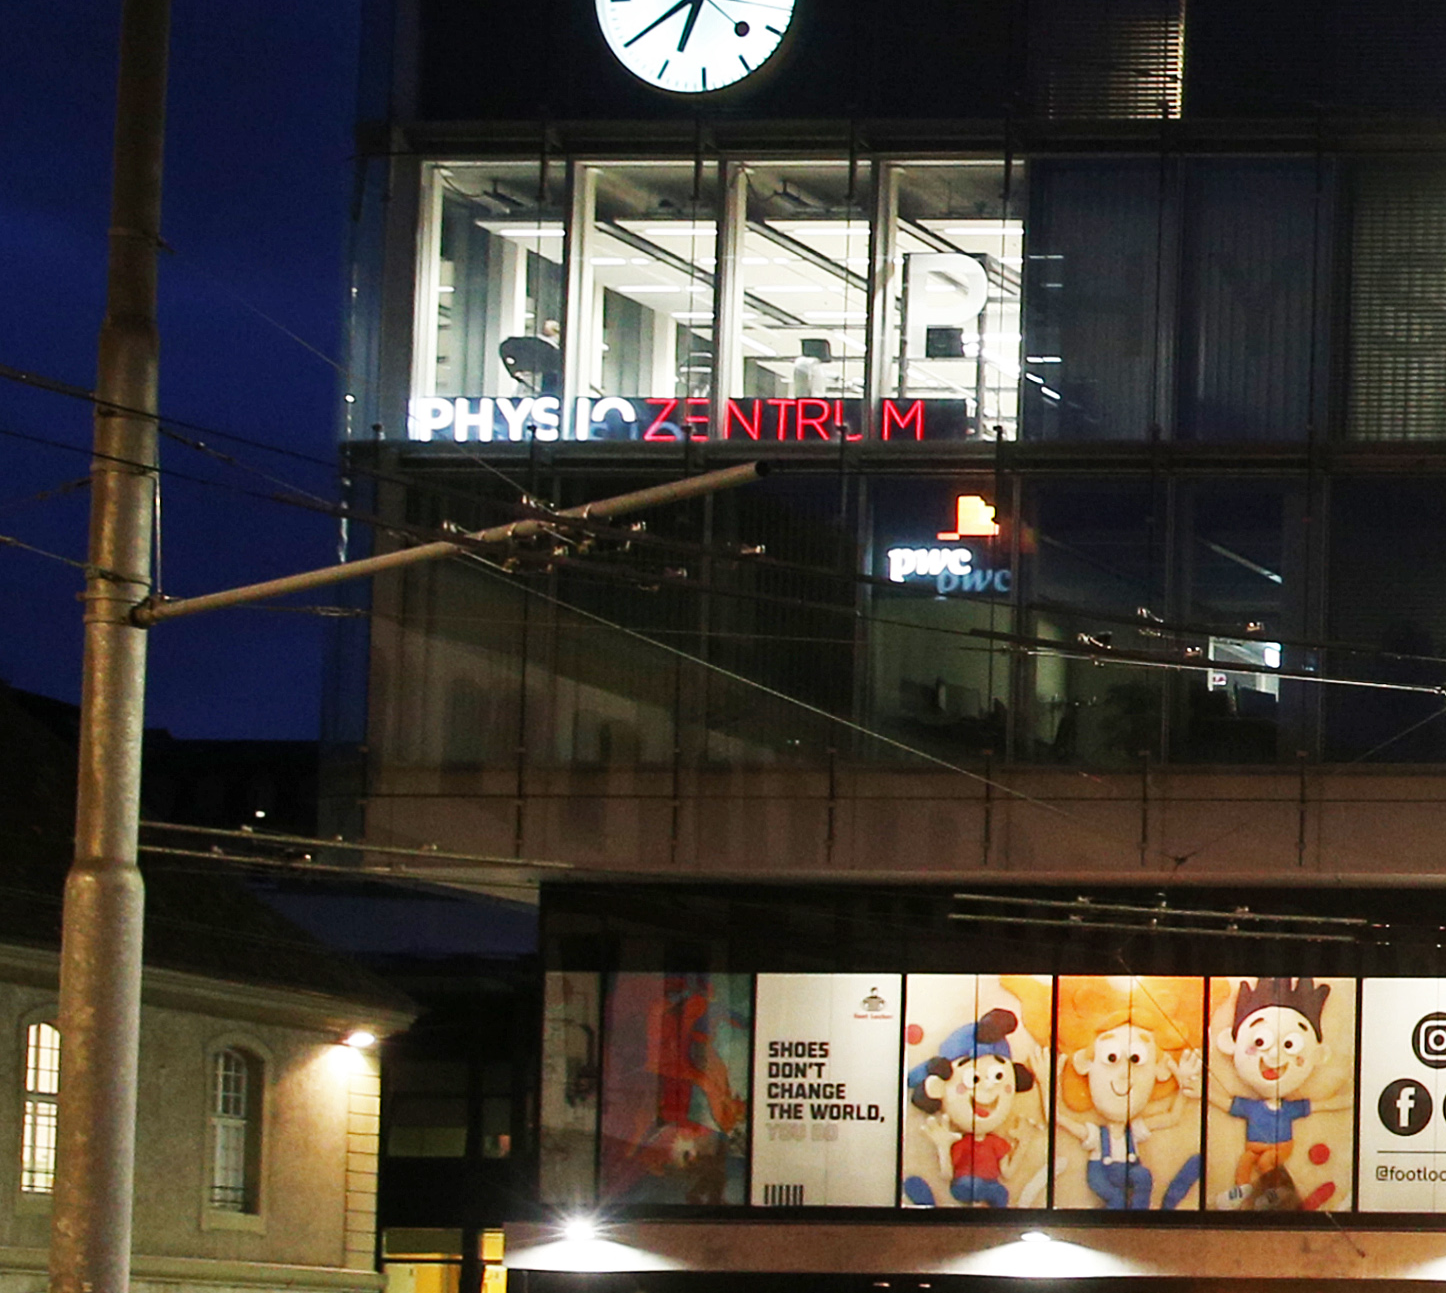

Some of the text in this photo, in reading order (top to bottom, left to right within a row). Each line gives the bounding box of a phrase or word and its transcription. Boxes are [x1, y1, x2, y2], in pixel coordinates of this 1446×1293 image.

[888, 547, 973, 583] pwc
[768, 1041, 829, 1058] SHOES
[768, 1062, 825, 1079] DON'T
[767, 1083, 846, 1100] CHANGE
[767, 1104, 885, 1123] THE WORLD,
